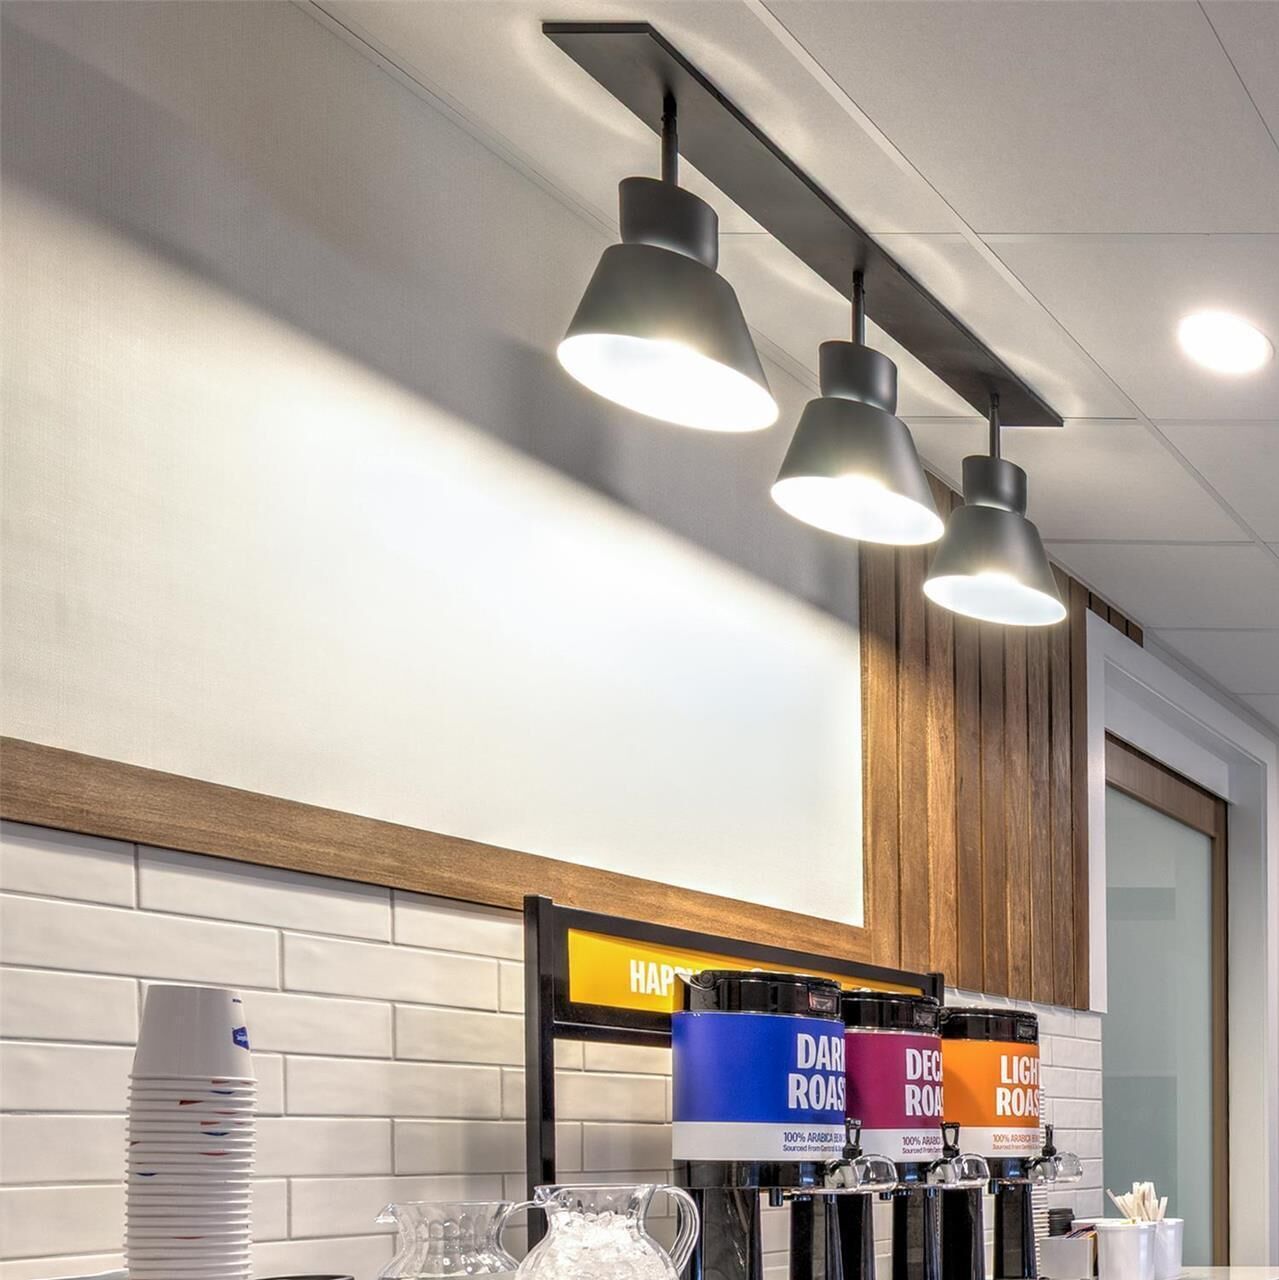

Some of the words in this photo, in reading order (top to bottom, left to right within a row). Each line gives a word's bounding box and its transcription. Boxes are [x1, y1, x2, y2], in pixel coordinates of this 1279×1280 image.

[629, 959, 700, 997] HAP
[905, 1048, 942, 1082] DEC
[788, 1073, 846, 1111] ROAS
[904, 1084, 943, 1116] ROA
[996, 1087, 1040, 1116] ROAS
[783, 1131, 806, 1143] 100%
[902, 1136, 921, 1146] 100%
